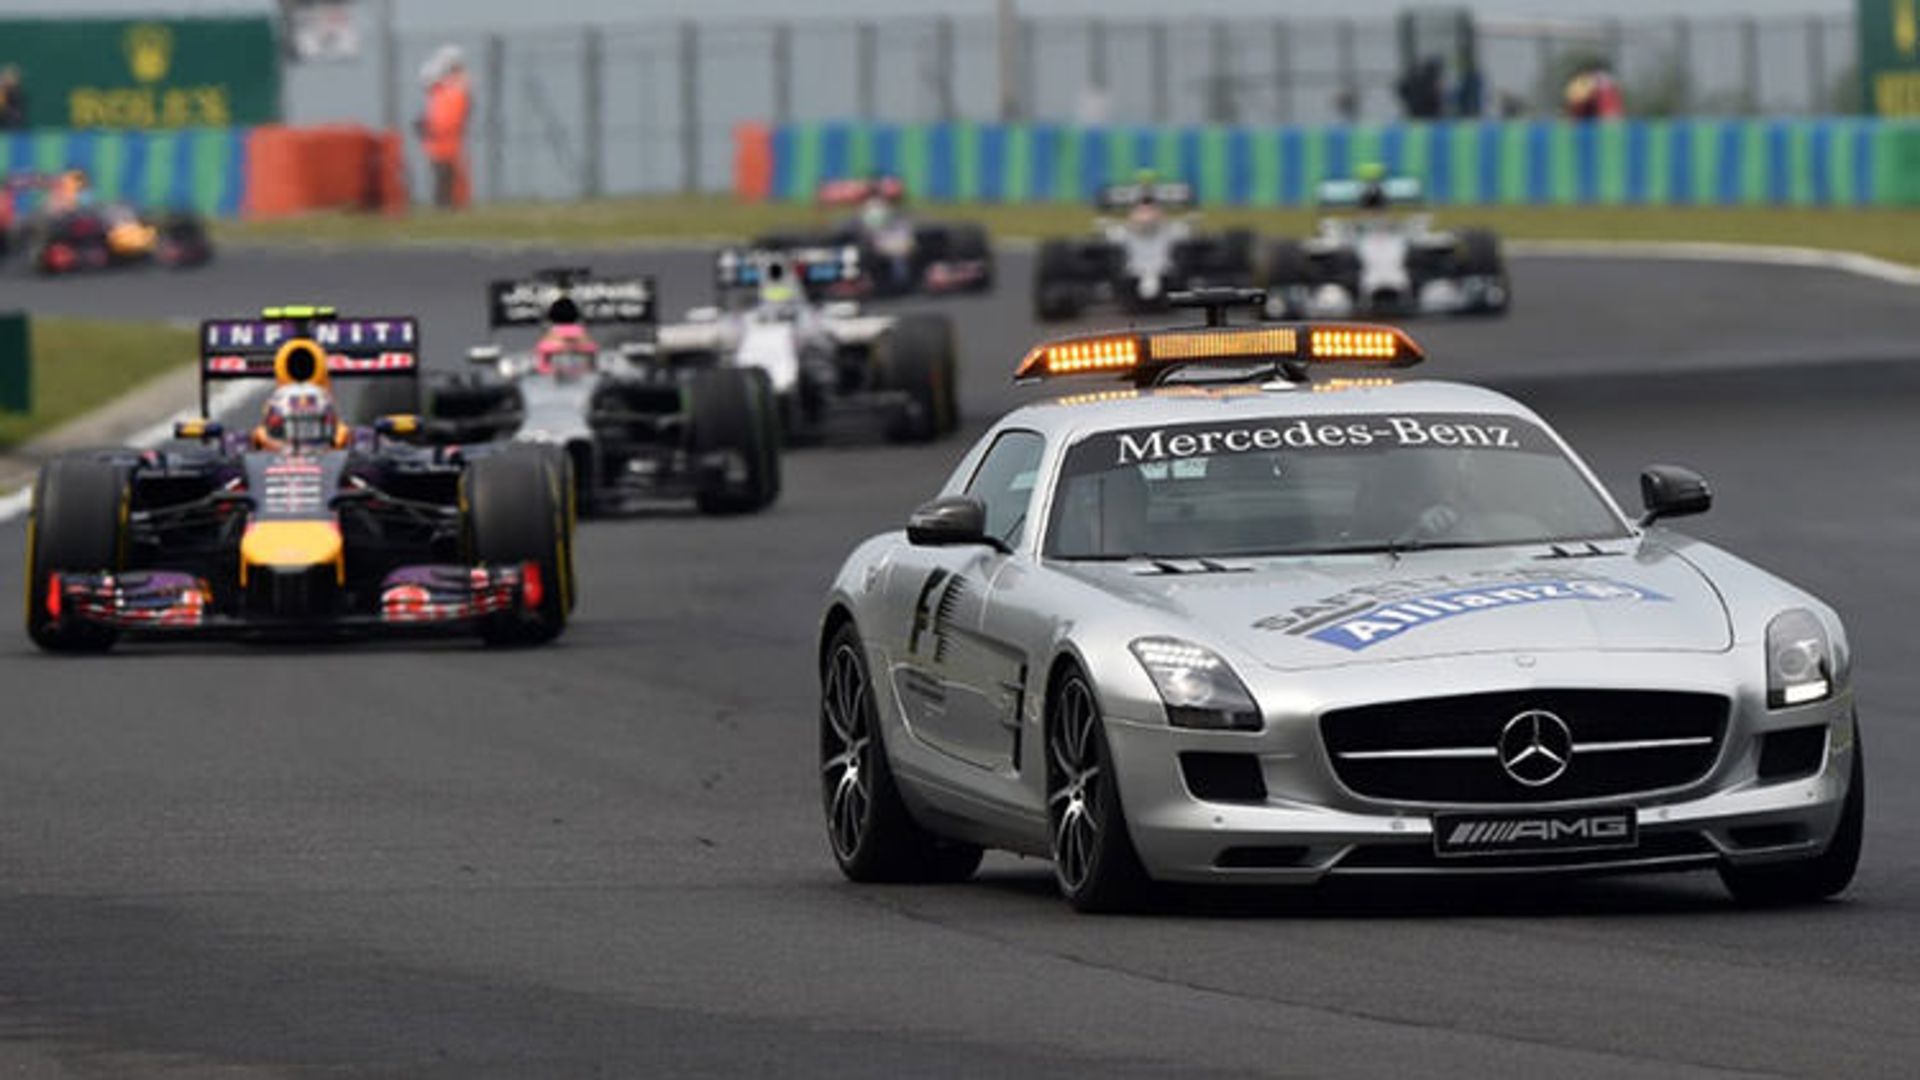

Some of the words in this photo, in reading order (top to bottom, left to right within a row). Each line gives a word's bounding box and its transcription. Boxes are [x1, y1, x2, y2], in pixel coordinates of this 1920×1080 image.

[208, 321, 414, 346] INFNITI
[1116, 416, 1520, 465] Mercedes-Benz
[1340, 584, 1566, 643] Allianz
